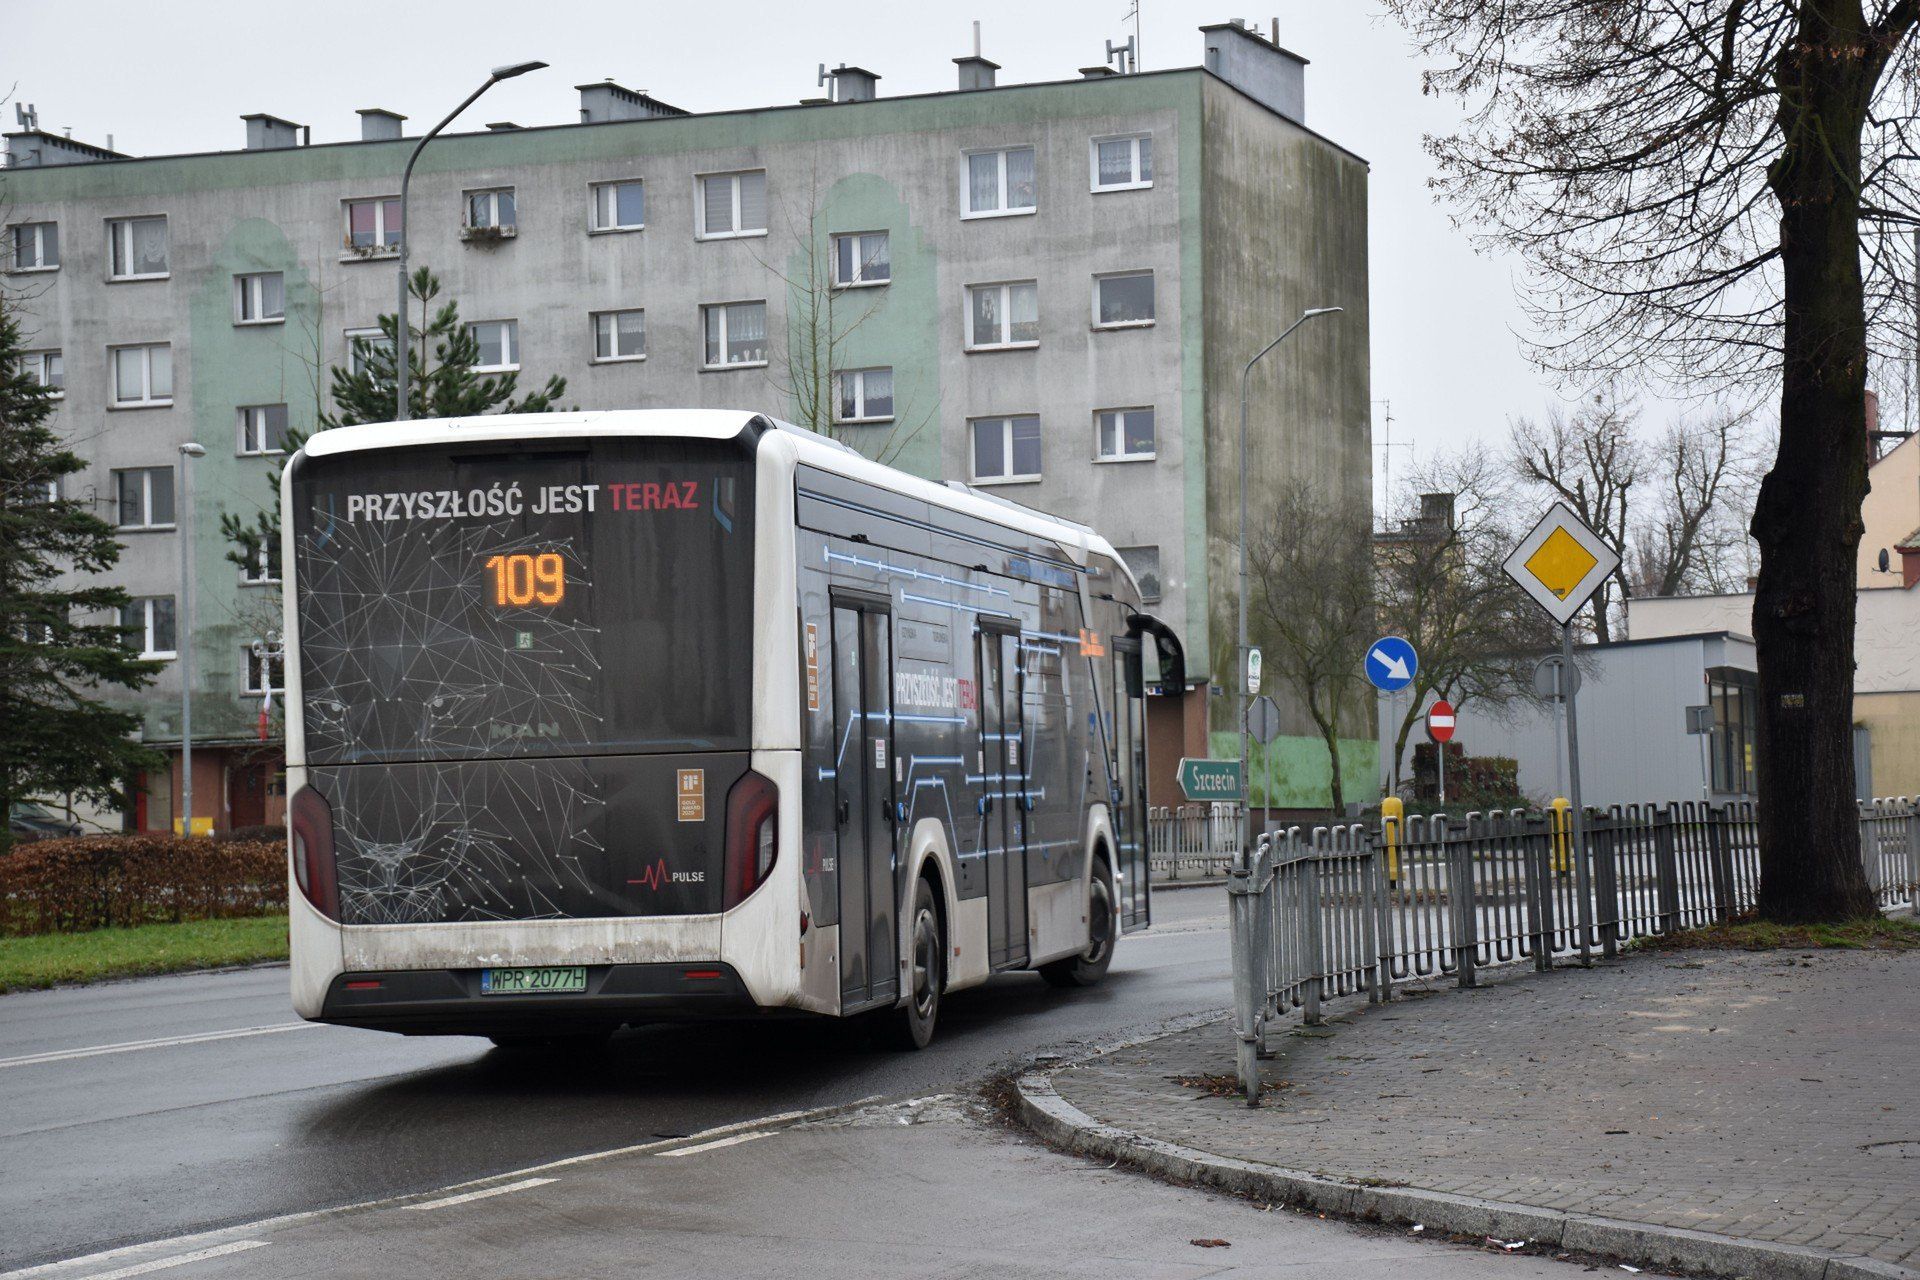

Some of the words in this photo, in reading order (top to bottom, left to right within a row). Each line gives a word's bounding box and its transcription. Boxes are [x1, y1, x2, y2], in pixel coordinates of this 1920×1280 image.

[347, 481, 523, 522] PRZYSZŁOŚĆ
[531, 484, 600, 514] JEST
[608, 481, 699, 511] TERAZ
[485, 553, 564, 605] 109
[940, 676, 958, 709] JEST
[491, 721, 560, 739] MAN
[1192, 765, 1236, 791] Szczecin
[672, 871, 705, 882] PULSE
[491, 970, 525, 989] WPR
[530, 968, 585, 988] 2077H
